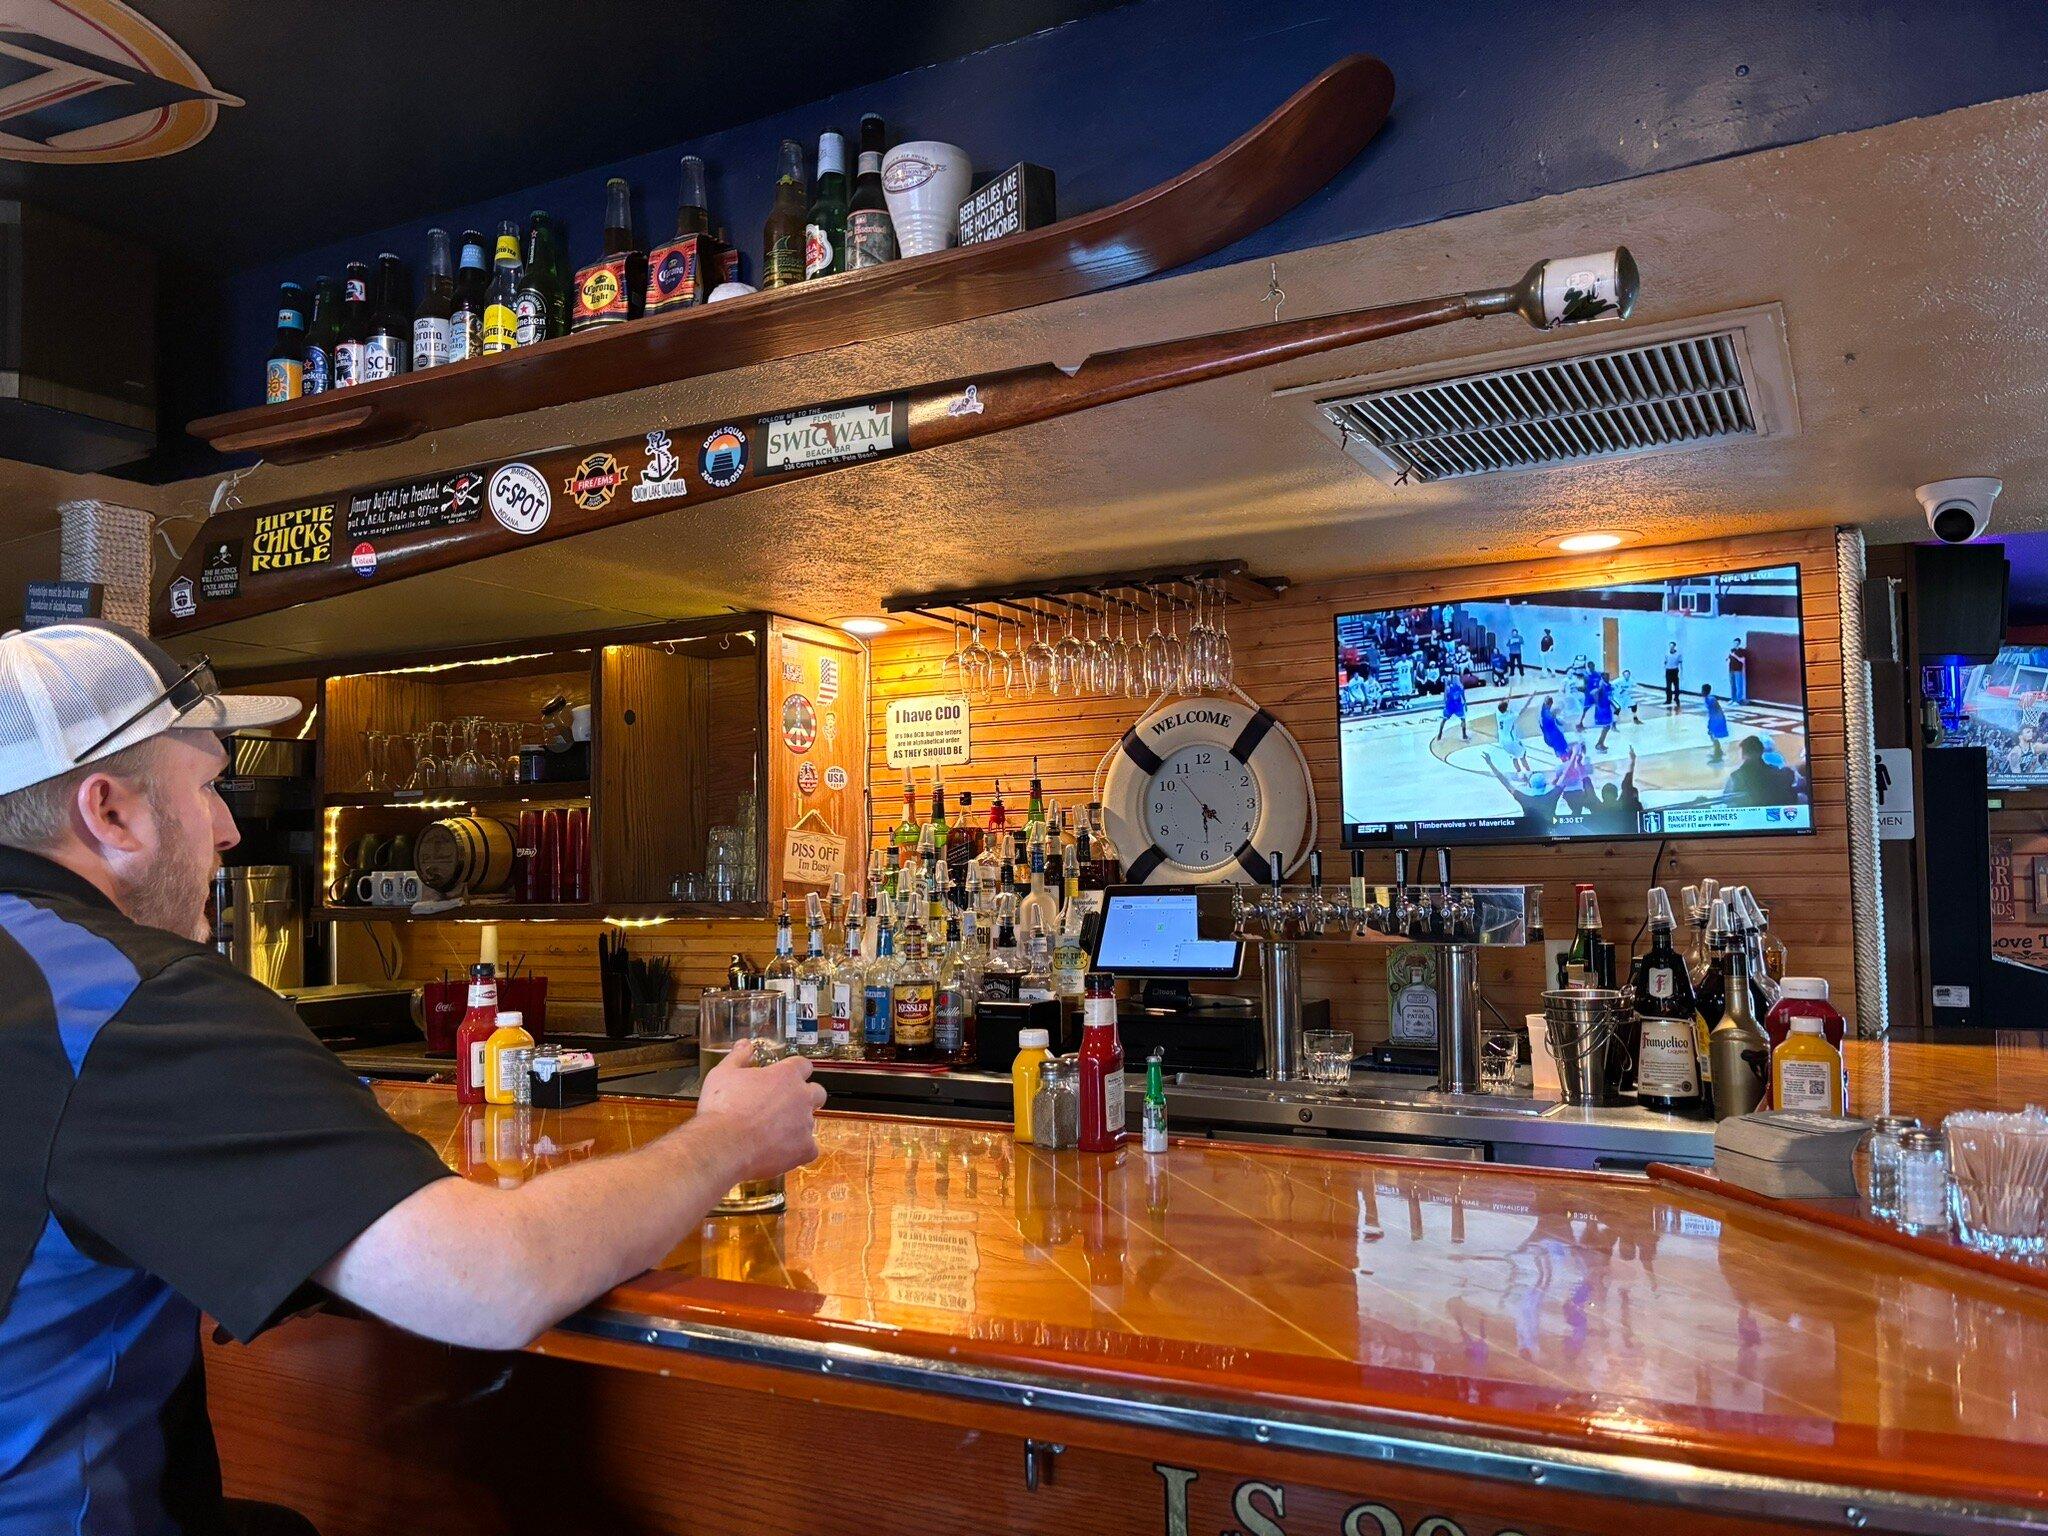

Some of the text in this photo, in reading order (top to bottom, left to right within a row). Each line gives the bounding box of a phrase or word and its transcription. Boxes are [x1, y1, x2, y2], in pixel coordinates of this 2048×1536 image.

[960, 171, 1018, 224] BEER BELLIES ARE
[961, 191, 1018, 242] THE HOLDER OF
[983, 210, 1018, 242] MEMORIES
[659, 267, 684, 282] Corona
[583, 284, 617, 297] Corona
[758, 413, 784, 424] FOLLOW
[785, 411, 796, 420] ME
[798, 410, 807, 418] TO
[813, 411, 846, 423] FLORIDA
[702, 426, 746, 449] DOCK SQUAD
[769, 415, 891, 455] SWIGWAM
[805, 444, 851, 458] BEACH BAR
[795, 461, 814, 470] Corey
[858, 451, 878, 460] Beach
[534, 481, 547, 497] LAKE
[577, 474, 614, 491] FIRE/EMS
[633, 480, 686, 501] SNOW LAKE INDIANA
[348, 496, 372, 518] Jimmy
[373, 489, 398, 512] Buffett
[398, 488, 410, 509] for
[495, 475, 545, 523] G-SPOT
[255, 504, 335, 535] HIPPIE
[347, 504, 439, 531] put a REAL Pirate in Office
[497, 508, 519, 528] INDIANA
[352, 519, 431, 537] www.margaritaville.com
[252, 522, 332, 554] CHICKS
[251, 543, 331, 572] RULE
[354, 555, 375, 566] Voted
[1720, 571, 1774, 584] NFL LIVE
[896, 705, 961, 723] I have CDO
[1151, 710, 1232, 737] WELCOME
[944, 728, 962, 736] letters
[912, 738, 945, 746] alphabetical
[893, 745, 963, 759] AS THEY SHOULD BE
[1195, 753, 1211, 765] 12
[1175, 764, 1190, 775] 11
[1223, 761, 1230, 771] 1
[827, 773, 845, 784] USA
[1240, 776, 1249, 787] 2
[1160, 780, 1176, 792] 10
[1155, 803, 1164, 814] 9
[1247, 798, 1256, 809] 3
[1417, 821, 1467, 830] Timberwolves
[1478, 818, 1516, 828] Mavericks
[1558, 816, 1584, 824] 8:30 ET
[1667, 814, 1697, 823] RANGERS
[1704, 813, 1738, 822] PANTHERS
[1878, 816, 1903, 826] MEN
[1161, 825, 1170, 836] 8
[1241, 821, 1250, 833] 4
[1357, 824, 1387, 834] ESPN
[791, 842, 840, 863] PISS OFF
[1176, 843, 1184, 854] 7
[1224, 842, 1233, 852] 5
[1200, 850, 1210, 861] 6
[811, 859, 831, 875] Busy
[1157, 987, 1177, 997] toast
[898, 1003, 928, 1013] KESSLER
[1641, 1032, 1689, 1050] Frangelico
